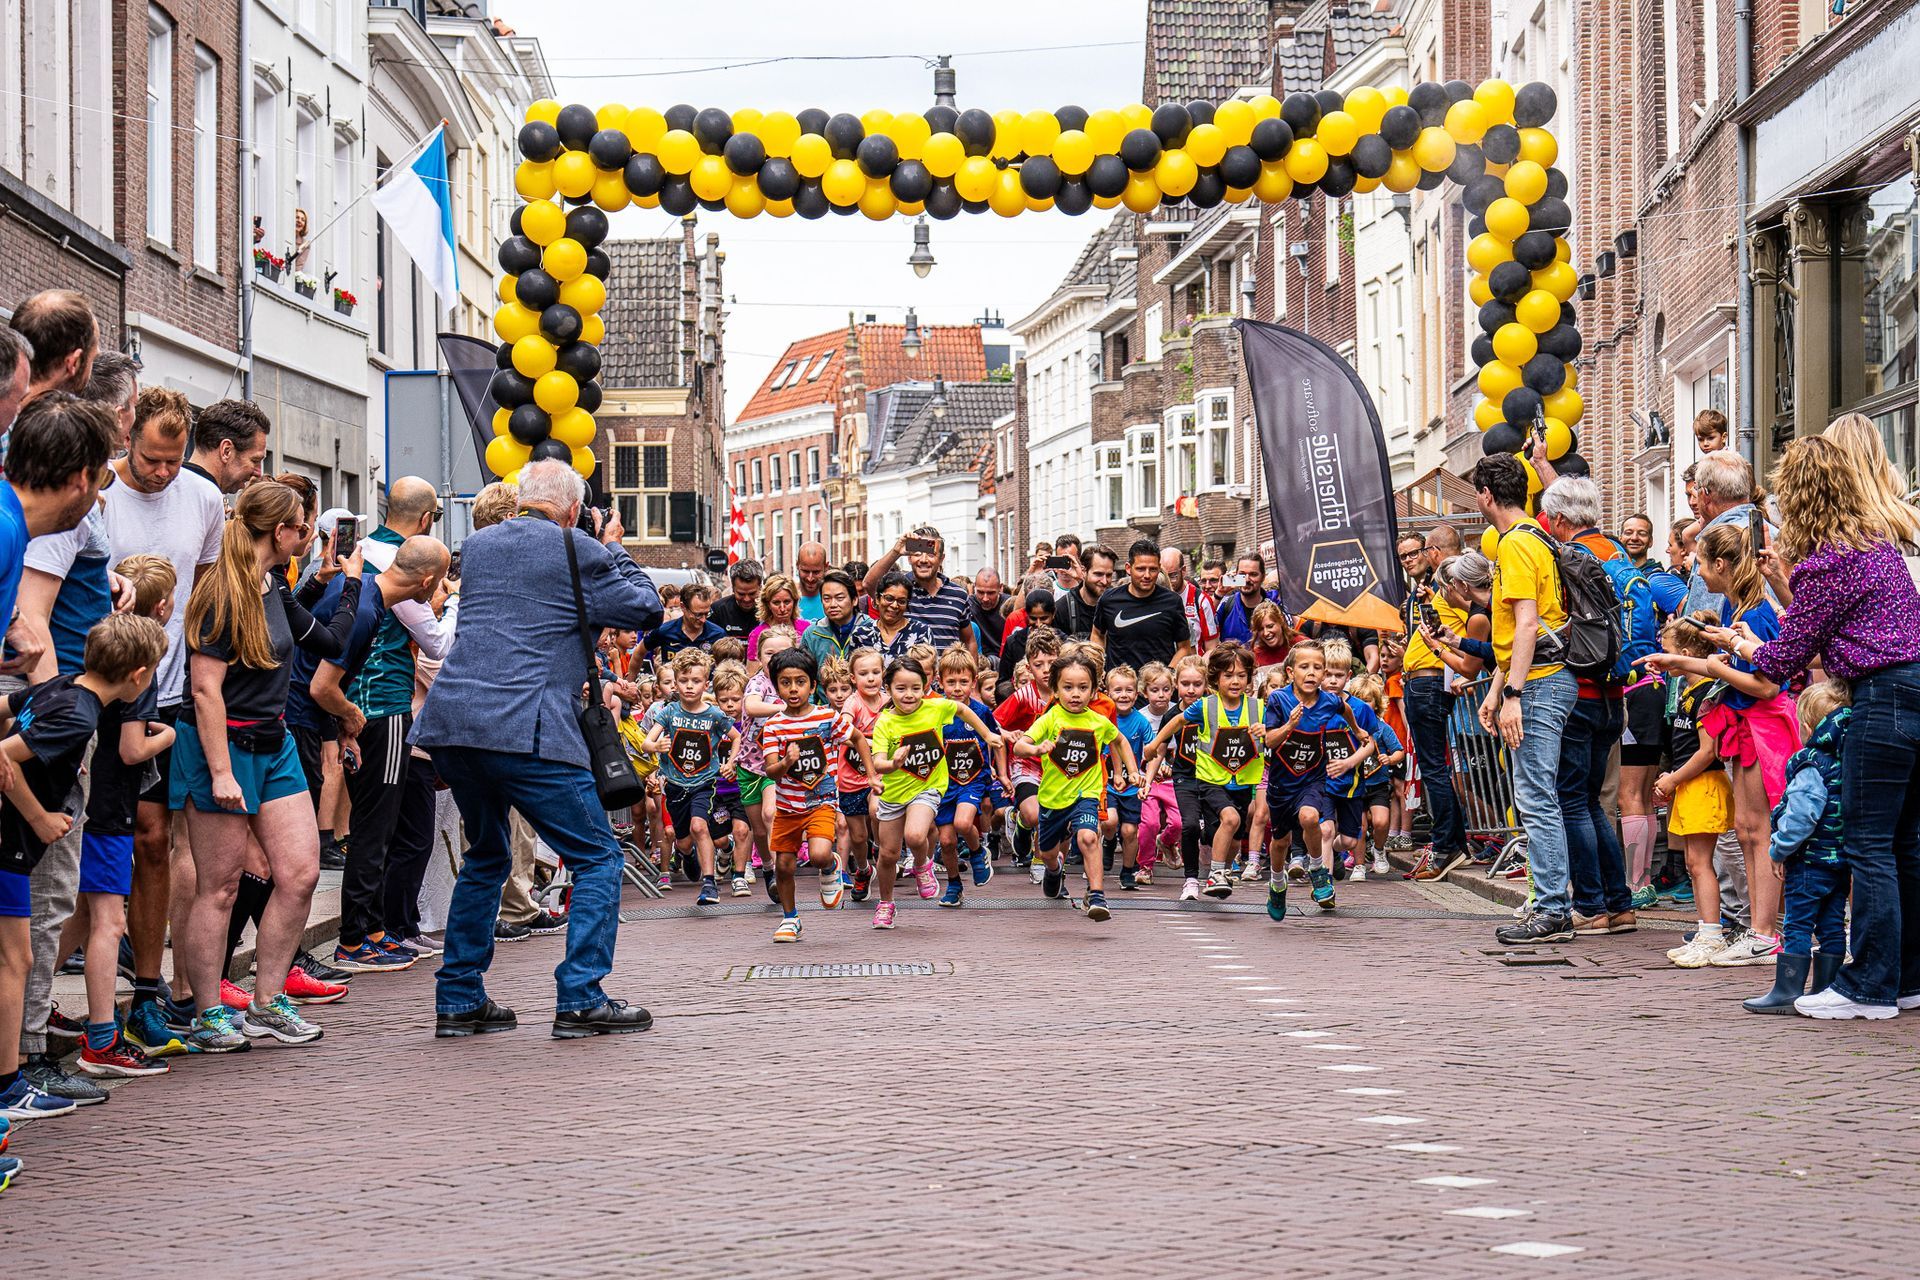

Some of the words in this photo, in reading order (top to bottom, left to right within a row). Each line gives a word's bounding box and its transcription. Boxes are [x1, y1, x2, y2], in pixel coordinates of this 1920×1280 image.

[678, 748, 702, 761] J86
[904, 748, 940, 767] M210
[1061, 748, 1088, 763] J89
[1222, 746, 1246, 758] J76
[1289, 750, 1315, 762] J57
[794, 756, 821, 772] J90
[951, 758, 974, 770] J29
[1079, 814, 1098, 825] SUR
